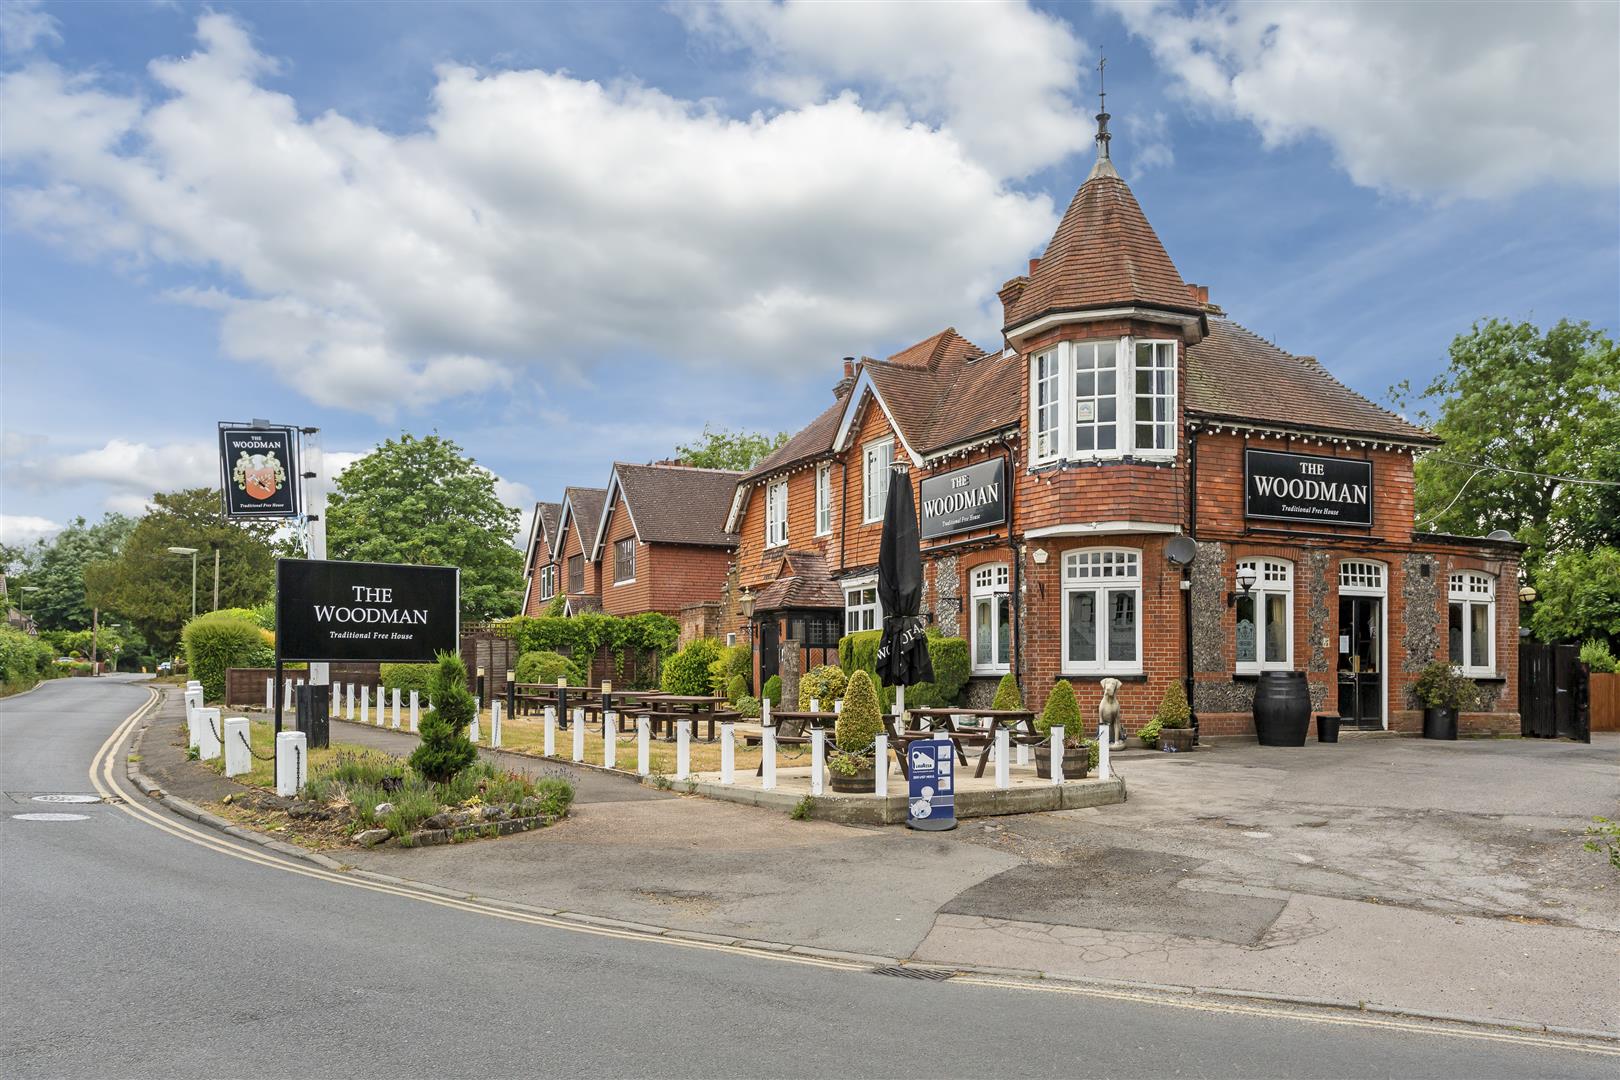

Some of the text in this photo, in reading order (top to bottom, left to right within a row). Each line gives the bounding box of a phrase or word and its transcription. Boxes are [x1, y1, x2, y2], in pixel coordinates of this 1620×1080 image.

[1300, 462, 1324, 475] THE
[951, 474, 968, 489] THE
[1253, 475, 1368, 504] WOODMAN
[924, 482, 999, 519] WOODMAN
[1281, 504, 1311, 513] Traditional
[1312, 506, 1323, 514] Free
[351, 586, 393, 603] THE
[313, 605, 429, 625] WOODMAN
[329, 631, 371, 639] Traditional
[391, 632, 414, 640] House
